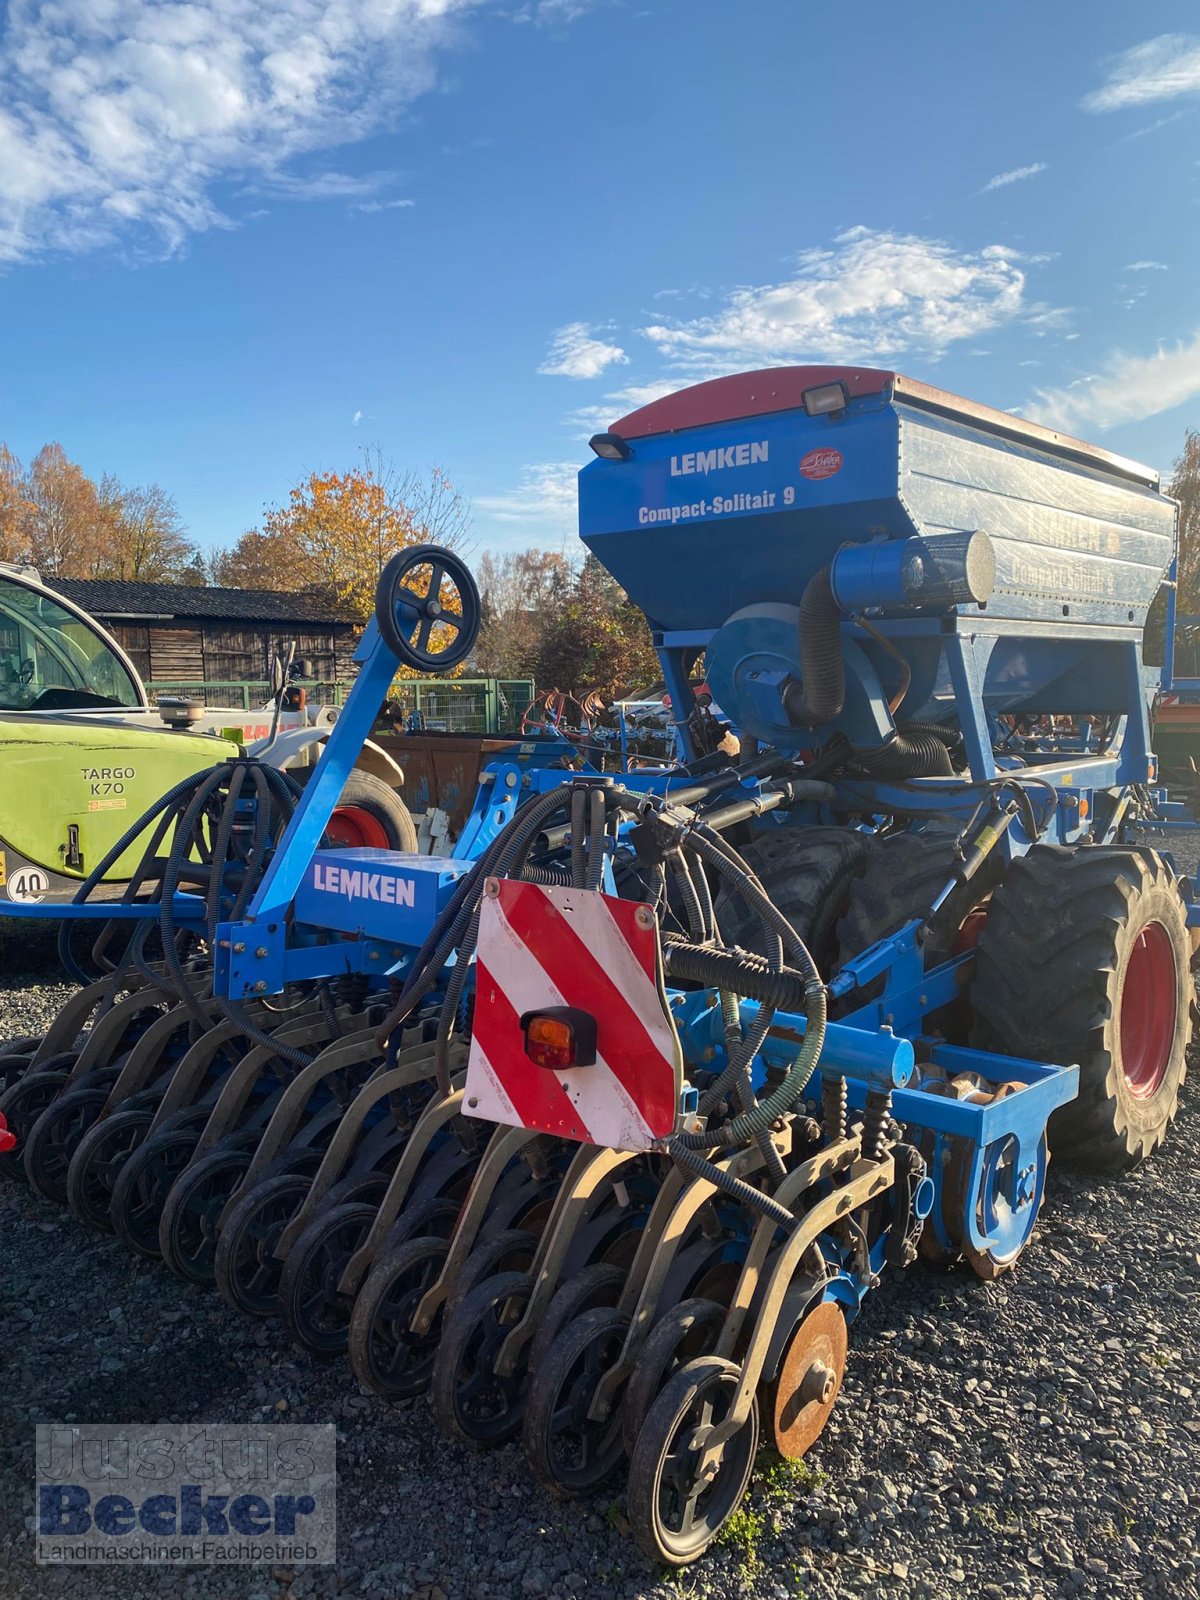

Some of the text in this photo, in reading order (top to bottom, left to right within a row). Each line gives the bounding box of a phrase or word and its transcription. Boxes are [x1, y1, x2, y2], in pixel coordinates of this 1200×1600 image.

[671, 440, 769, 477] LEMKEN
[638, 486, 795, 524] Compact-Solitair 9
[80, 767, 135, 780] TARGO
[91, 782, 124, 795] K70
[16, 873, 41, 899] 40
[314, 864, 415, 907] LEMKEN
